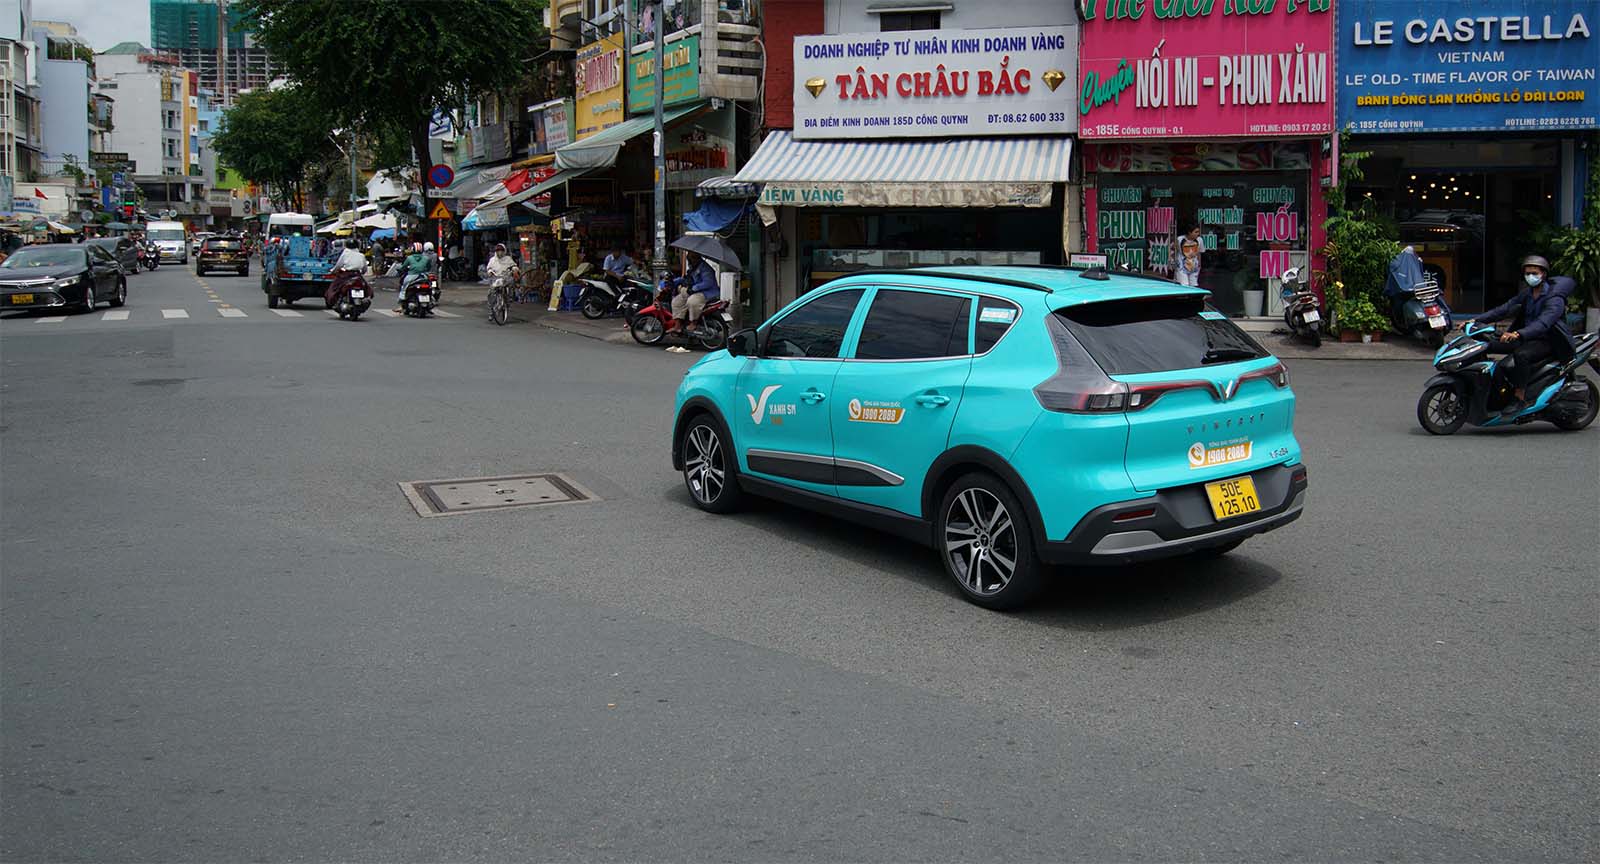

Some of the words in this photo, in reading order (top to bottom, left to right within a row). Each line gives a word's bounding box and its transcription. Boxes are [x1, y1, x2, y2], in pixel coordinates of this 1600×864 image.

[1354, 20, 1394, 46] LE
[1404, 13, 1591, 44] CASTELLA
[804, 43, 844, 59] DOANH
[847, 38, 890, 60] NGHIỆP
[894, 38, 911, 55] TƯ
[914, 36, 948, 55] NHÂN
[952, 38, 980, 54] KINH
[984, 37, 1026, 53] DOANH
[1031, 32, 1064, 51] VÀNG
[1438, 51, 1505, 64] VIETNAM
[835, 66, 889, 99] TÂN
[896, 64, 969, 98] CHÂU
[977, 55, 1031, 96] BẮC
[1136, 39, 1169, 108] NỐI
[1175, 57, 1198, 106] MI
[1219, 54, 1272, 105] PHUN
[1278, 43, 1326, 104] XĂM
[1371, 73, 1401, 85] OLD
[1412, 72, 1445, 85] TIME
[1450, 71, 1508, 83] FLAVOR
[1512, 70, 1532, 83] OF
[1537, 68, 1595, 81] TAIWAN
[1081, 58, 1136, 115] Chuyên
[1392, 92, 1427, 105] BÔNG
[1428, 93, 1454, 104] LAN
[1523, 88, 1546, 102] ĐÀI
[1548, 90, 1585, 102] LOAN
[842, 118, 861, 127] KINH
[864, 117, 890, 126] DOANH
[893, 116, 914, 126] 185D
[916, 114, 938, 125] CÔNG
[1029, 113, 1046, 122] 600
[1049, 112, 1065, 122] 333
[1096, 124, 1119, 135] 185E
[1250, 124, 1281, 133] HOTLINE:
[1282, 124, 1301, 132] 0903
[1302, 123, 1310, 131] 17
[1311, 123, 1321, 131] 20
[1322, 123, 1331, 131] 21
[801, 185, 844, 202] VÀNG
[1102, 185, 1142, 203] CHUYÊN
[1253, 185, 1295, 203] CHUYÊN
[1099, 210, 1145, 239] PHUN
[1198, 208, 1223, 224] PHUN
[1256, 202, 1298, 241] NỐI
[1104, 242, 1144, 272] XĂM
[1151, 244, 1169, 265] 250
[1260, 250, 1290, 279] MI
[769, 404, 786, 415] XANH
[787, 404, 797, 416] SM
[1220, 480, 1243, 499] 50E
[1219, 495, 1256, 517] 125.10
